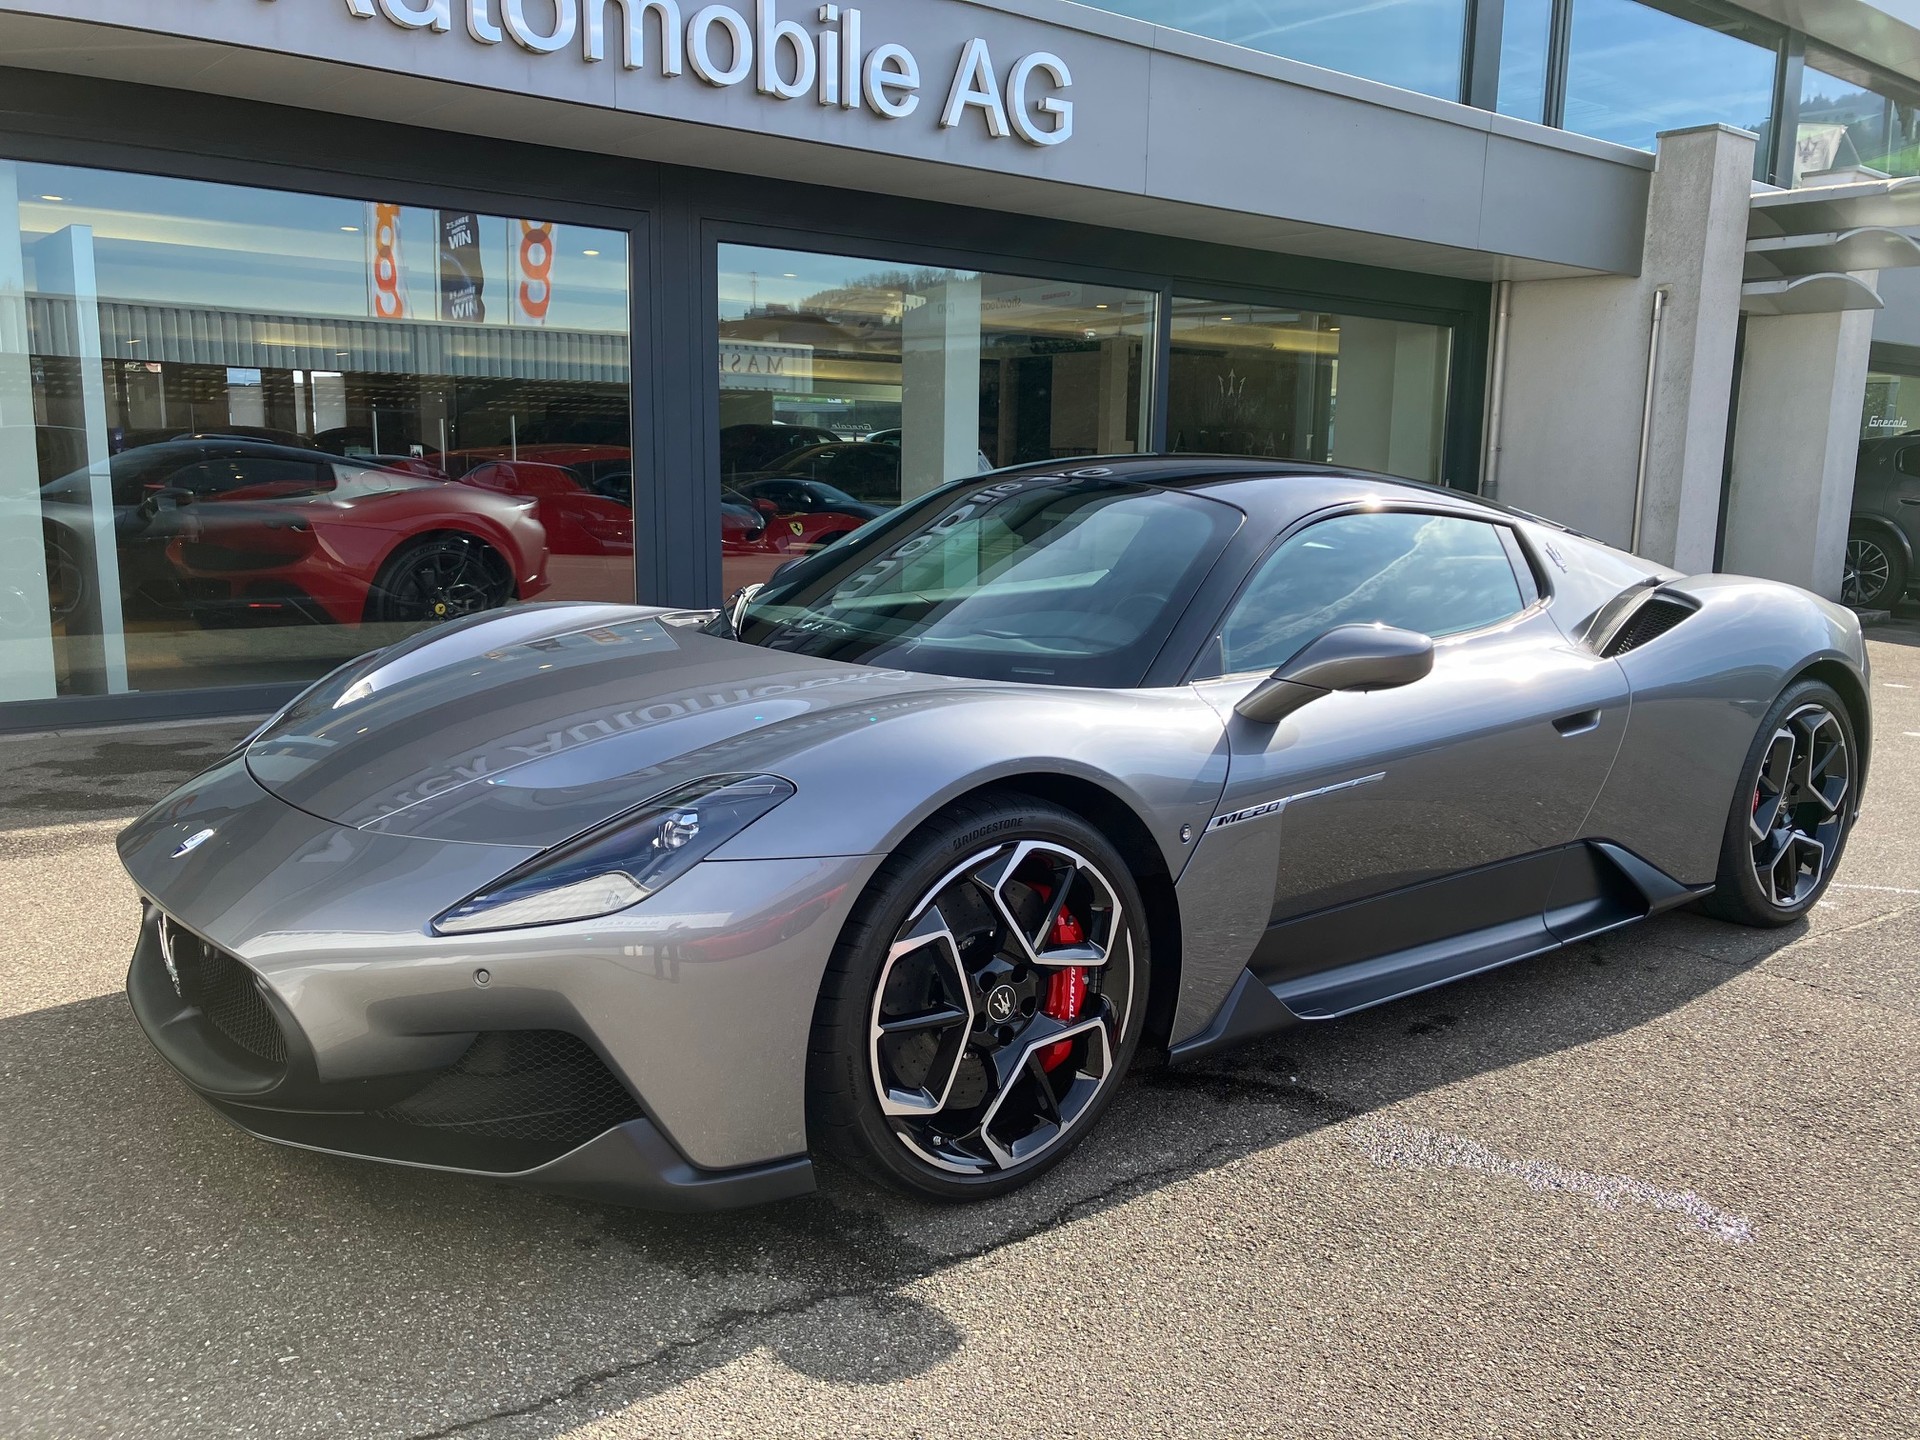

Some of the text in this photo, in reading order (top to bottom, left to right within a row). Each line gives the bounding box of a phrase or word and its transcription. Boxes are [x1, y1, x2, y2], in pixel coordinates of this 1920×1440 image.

[938, 36, 1074, 147] AG
[447, 229, 472, 250] WIN
[451, 301, 479, 319] WIN
[1868, 415, 1908, 428] Grecale
[1216, 801, 1281, 827] MC20
[952, 817, 1024, 851] BRIDGESTONE
